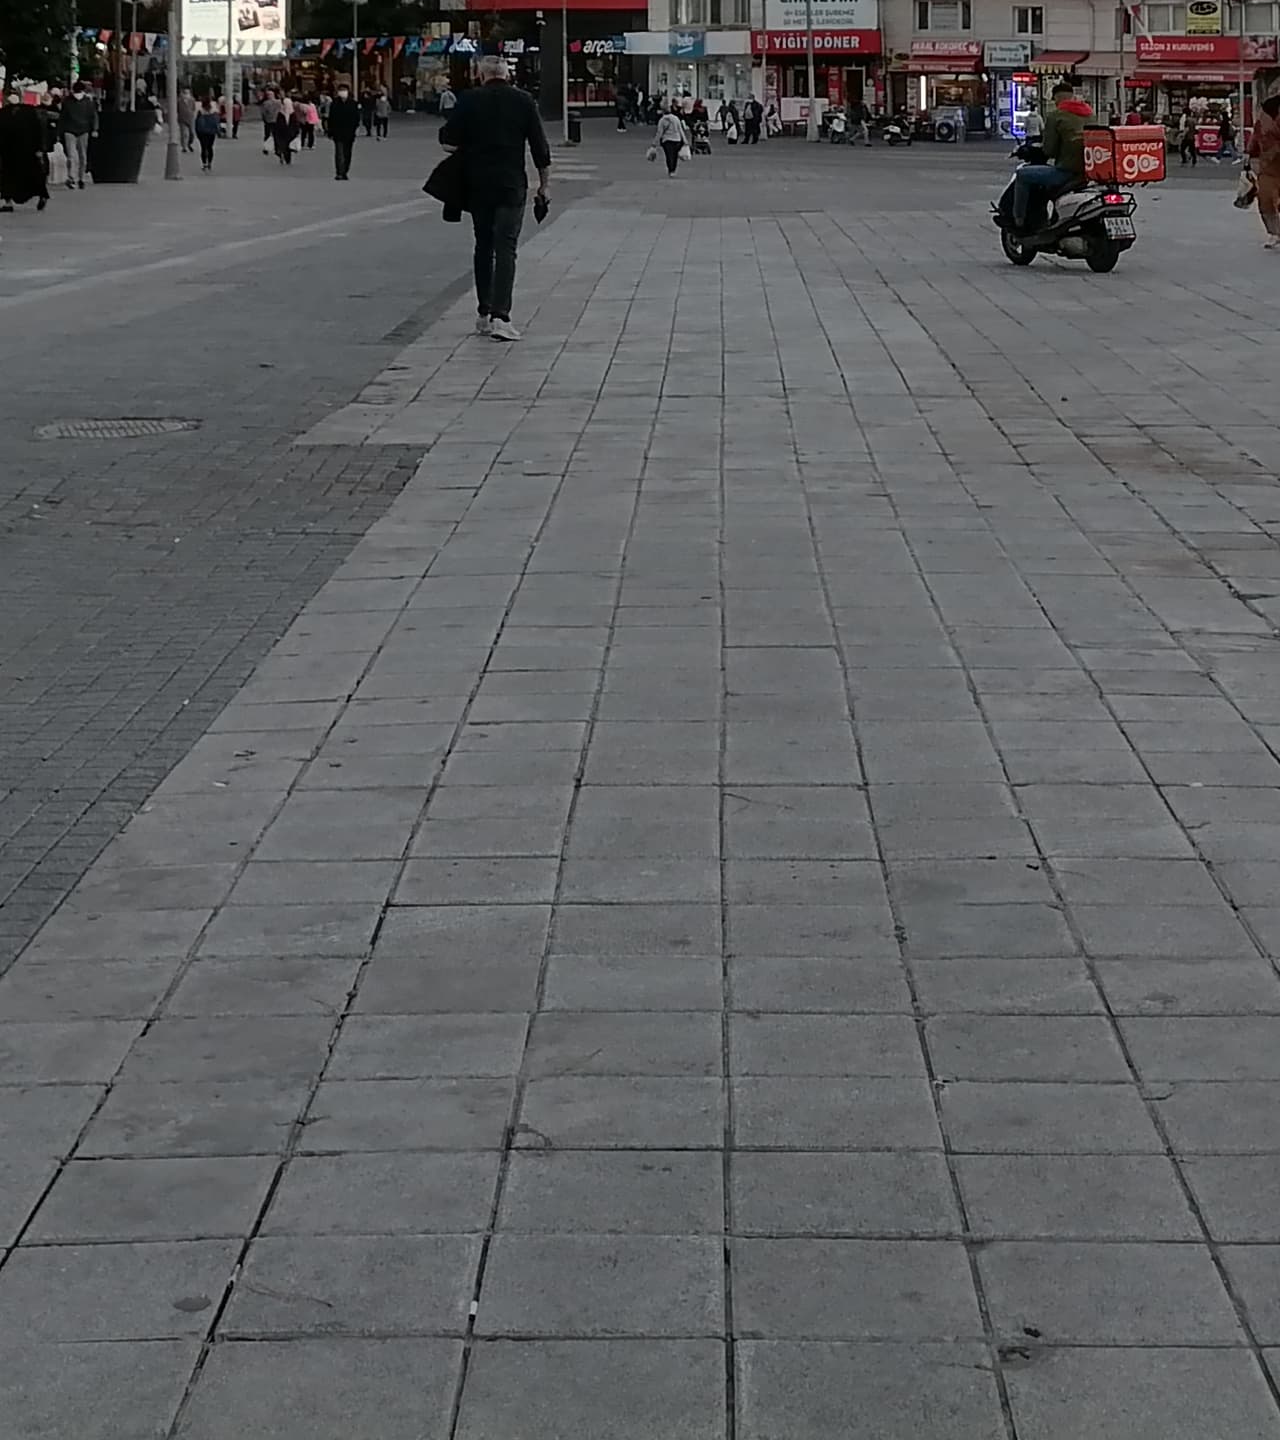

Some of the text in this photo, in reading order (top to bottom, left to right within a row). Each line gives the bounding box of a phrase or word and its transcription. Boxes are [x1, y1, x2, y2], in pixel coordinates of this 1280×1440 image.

[773, 32, 860, 49] YİĞİT DÖNER
[1122, 153, 1160, 179] go
